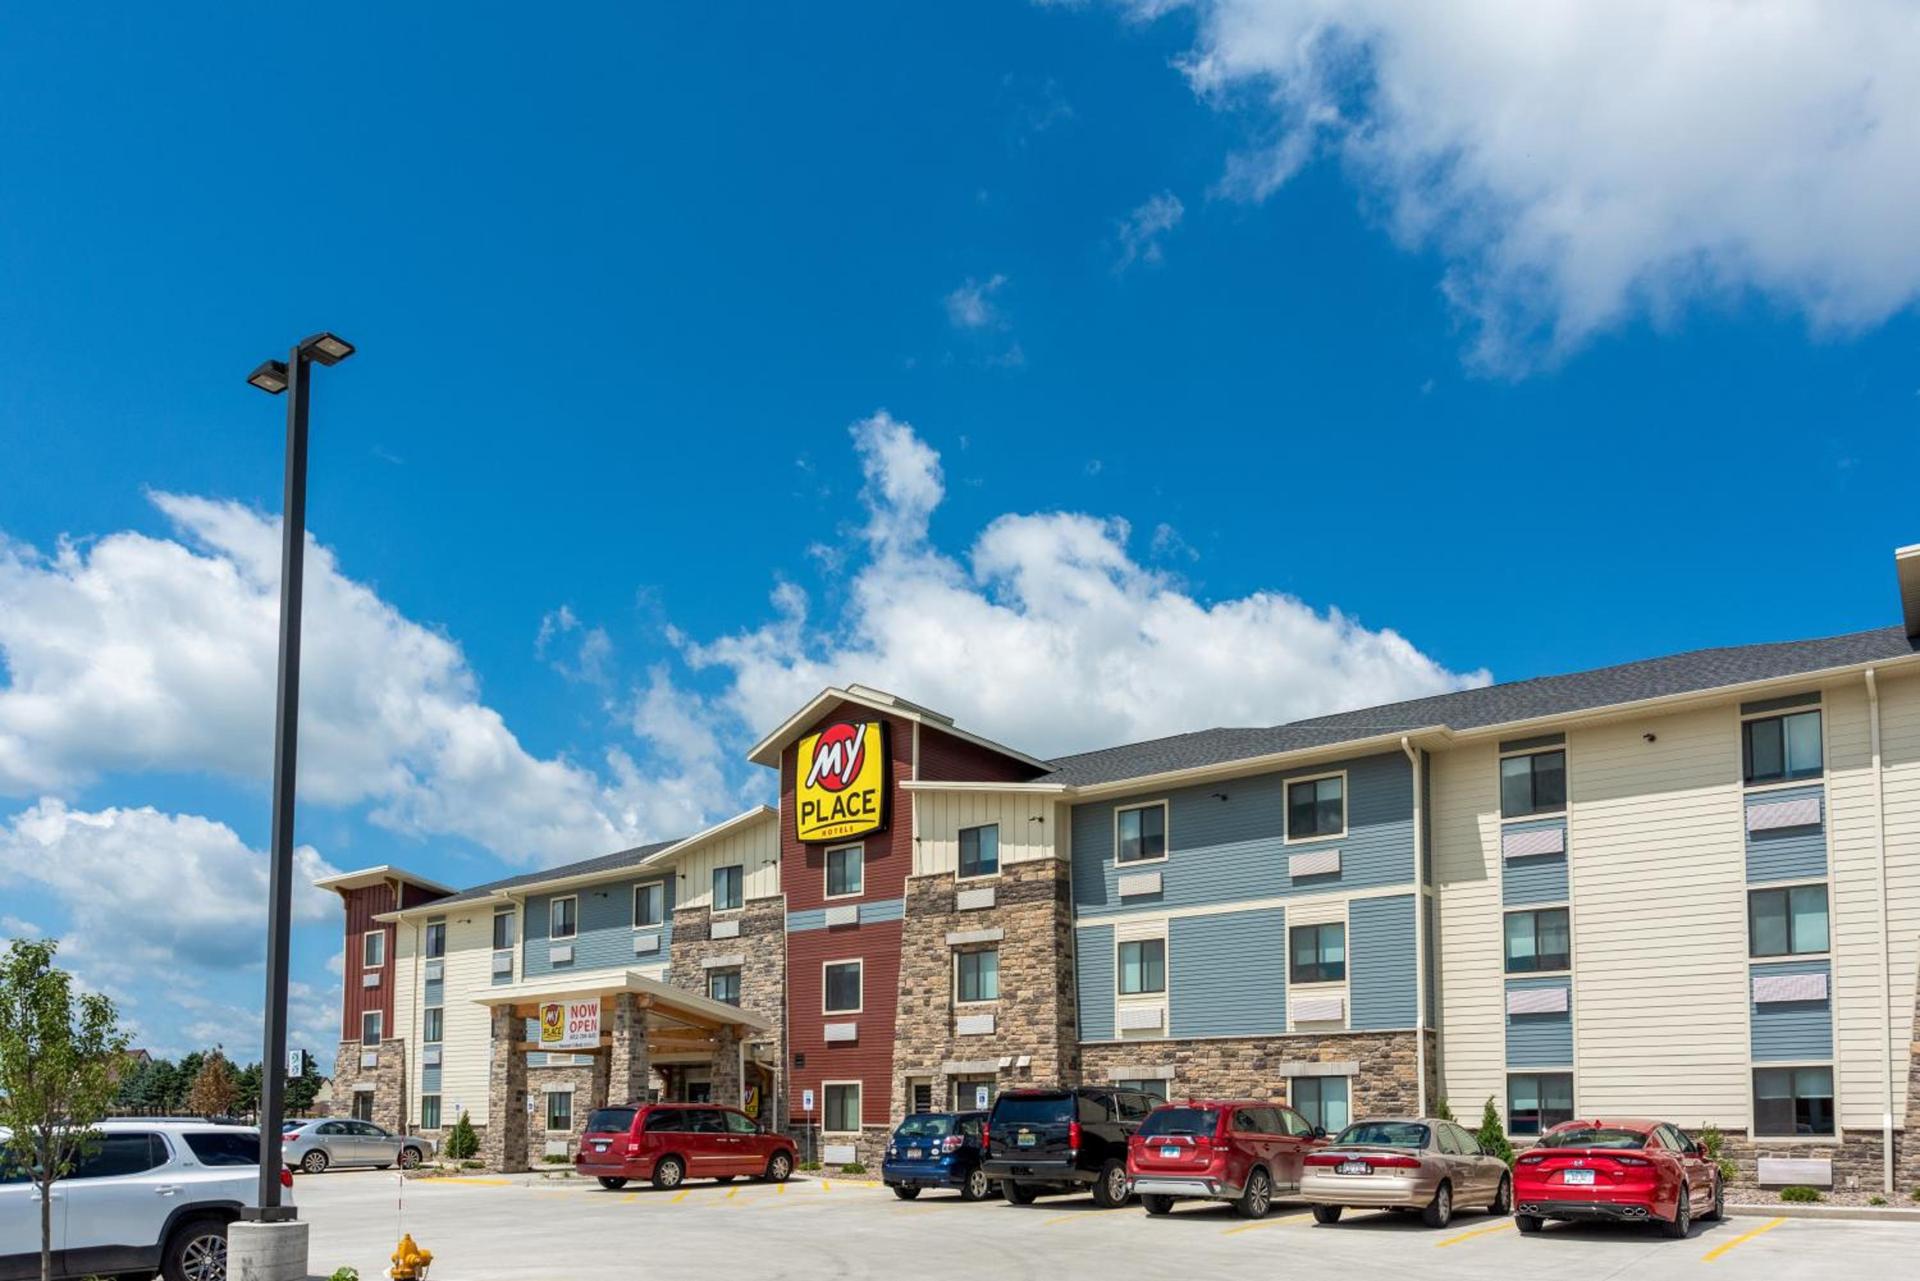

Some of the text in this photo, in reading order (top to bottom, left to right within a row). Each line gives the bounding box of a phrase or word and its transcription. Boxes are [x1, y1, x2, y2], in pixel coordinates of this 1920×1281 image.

[801, 789, 876, 825] PLACE
[821, 826, 854, 837] HOTELS
[570, 1004, 597, 1018] NOW
[569, 1019, 597, 1033] OPEN
